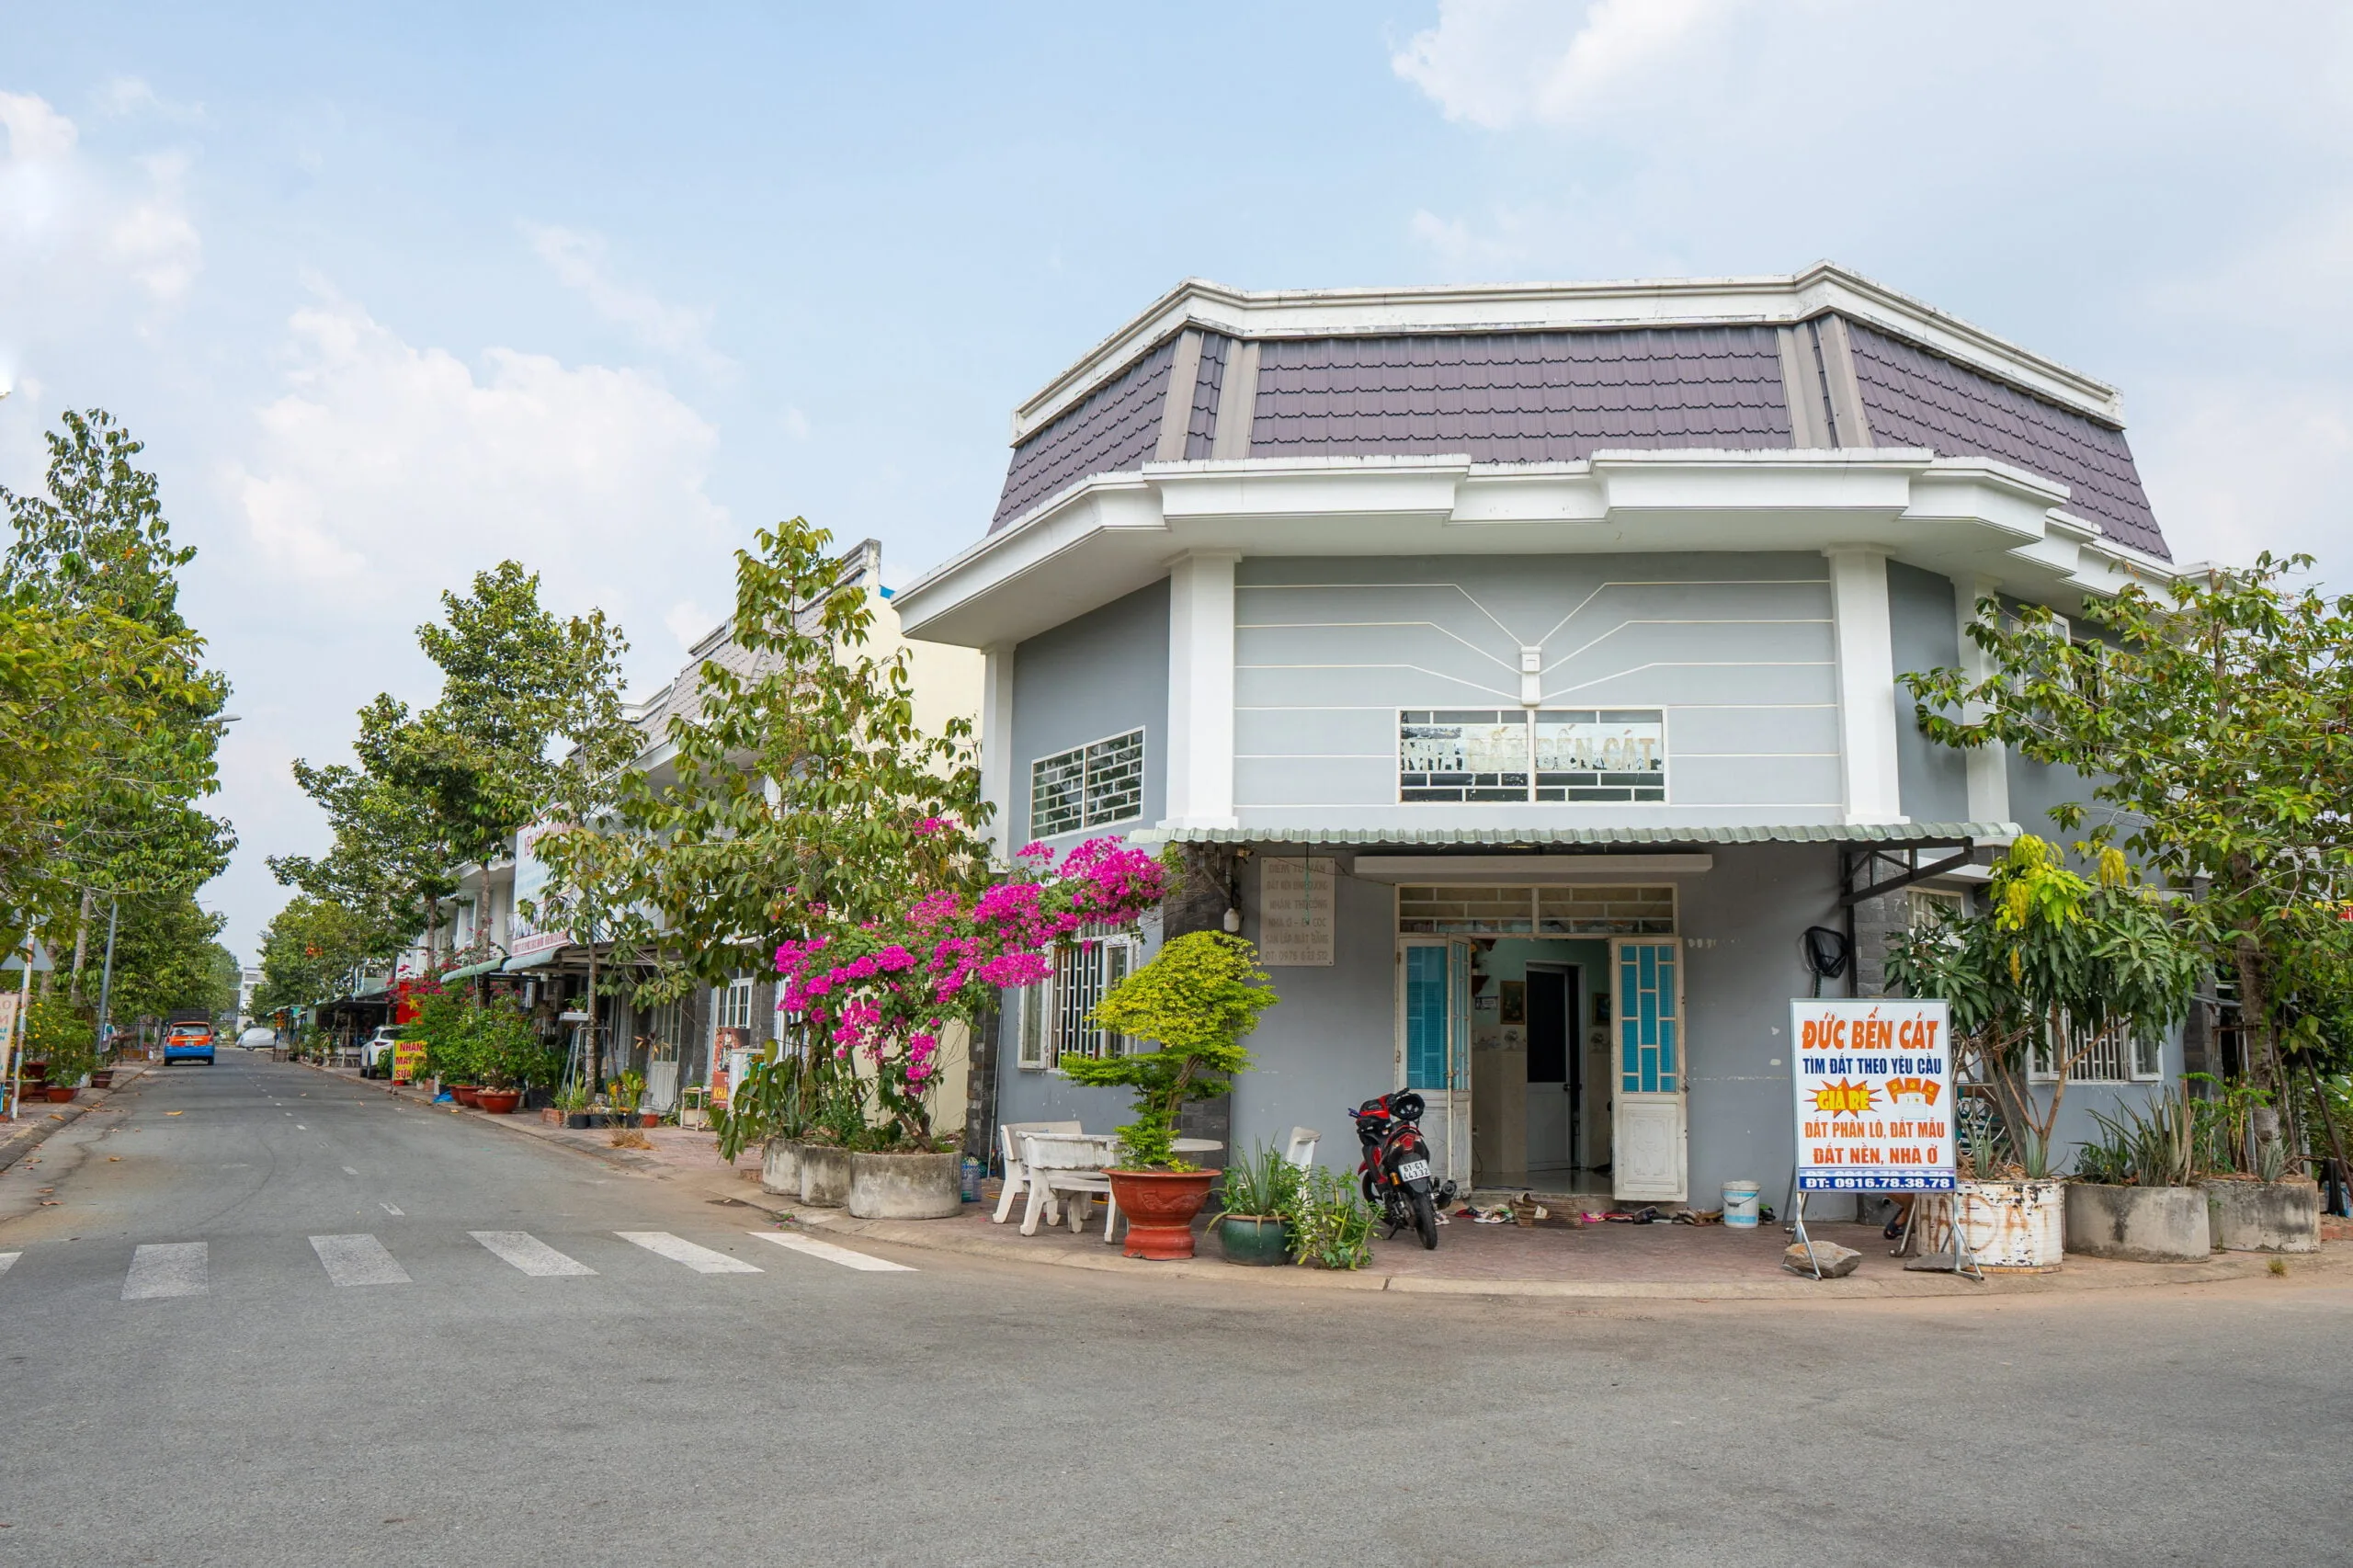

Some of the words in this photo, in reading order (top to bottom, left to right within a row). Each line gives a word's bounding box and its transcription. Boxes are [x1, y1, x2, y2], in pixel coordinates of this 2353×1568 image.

[1602, 729, 1655, 770] CÁT
[1802, 1011, 1847, 1050] ĐỨC
[1851, 1006, 1893, 1050] BẾN
[1899, 1012, 1938, 1050] CÁT
[1802, 1055, 1825, 1074] TÌM
[1829, 1052, 1852, 1074] ĐẤT
[1857, 1058, 1887, 1074] THEO
[1891, 1055, 1913, 1074] YÊU
[1917, 1052, 1942, 1074] CẦU
[1816, 1085, 1846, 1111] GIÁ
[1849, 1085, 1870, 1111] RẺ
[1804, 1117, 1828, 1138] ĐẤT
[1833, 1119, 1865, 1138] PHÂN
[1870, 1119, 1886, 1140] LÔ,
[1890, 1117, 1914, 1138] ĐẤT
[1917, 1117, 1945, 1138] MẪU
[1813, 1142, 1844, 1165] ĐẤT
[1849, 1142, 1884, 1165] NỀN,
[1889, 1144, 1923, 1164] NHÀ
[1927, 1144, 1938, 1164] Ở
[1805, 1177, 1830, 1188] ĐT:
[1835, 1177, 1950, 1188] 0916.78.38.78
